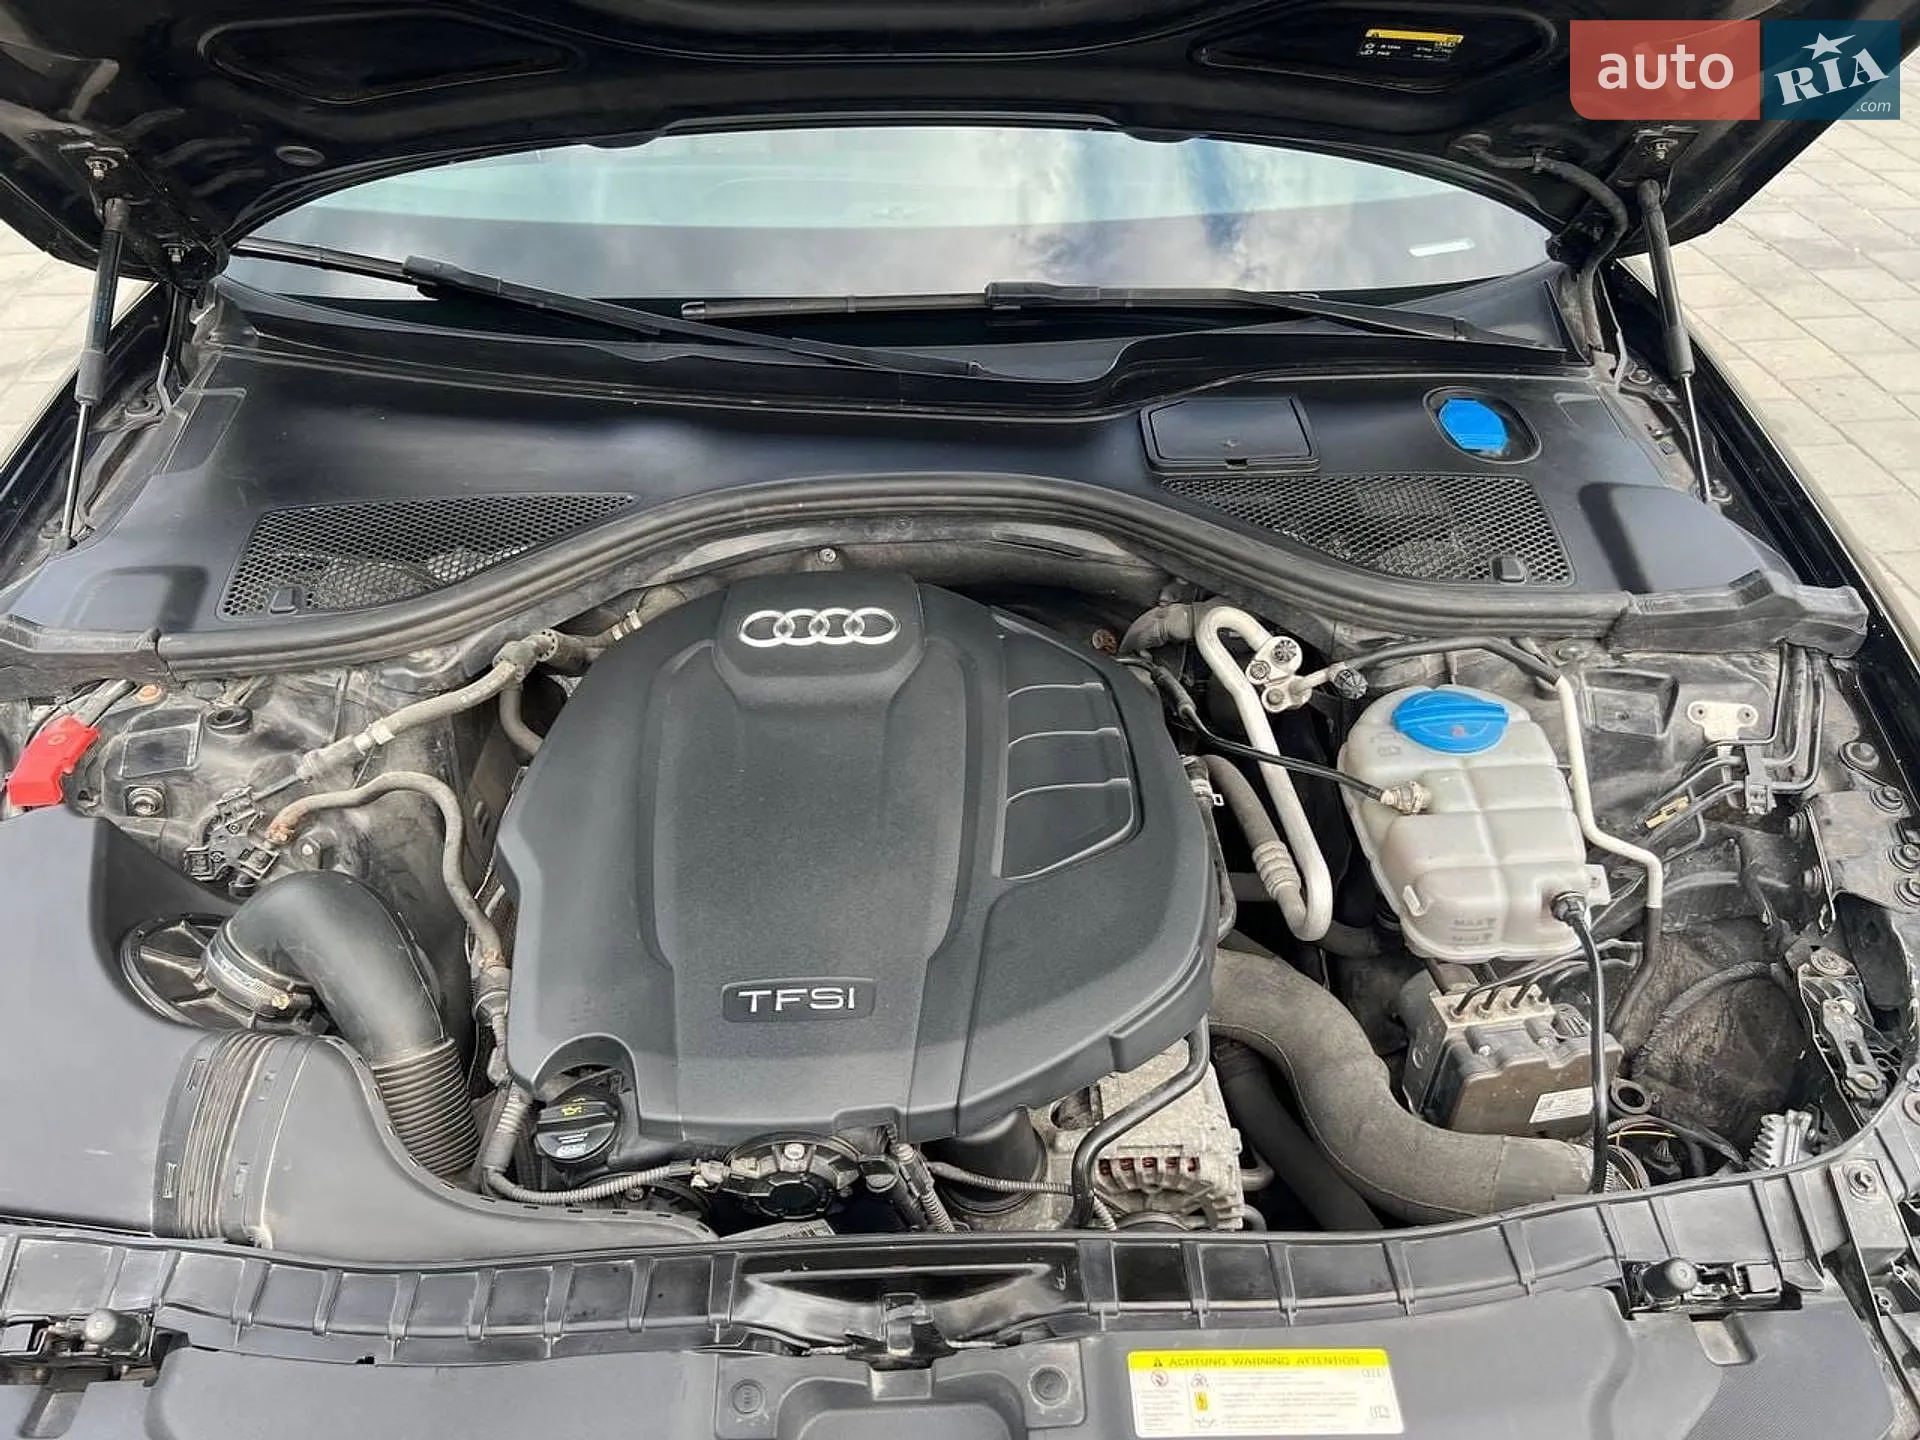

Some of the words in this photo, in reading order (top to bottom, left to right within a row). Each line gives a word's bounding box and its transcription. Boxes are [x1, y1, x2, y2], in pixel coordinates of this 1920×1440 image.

[738, 987, 855, 1013] TFSI
[1168, 1356, 1226, 1367] ACHTUNG
[1231, 1355, 1290, 1366] WARNING
[1295, 1355, 1360, 1366] ATTENTION
